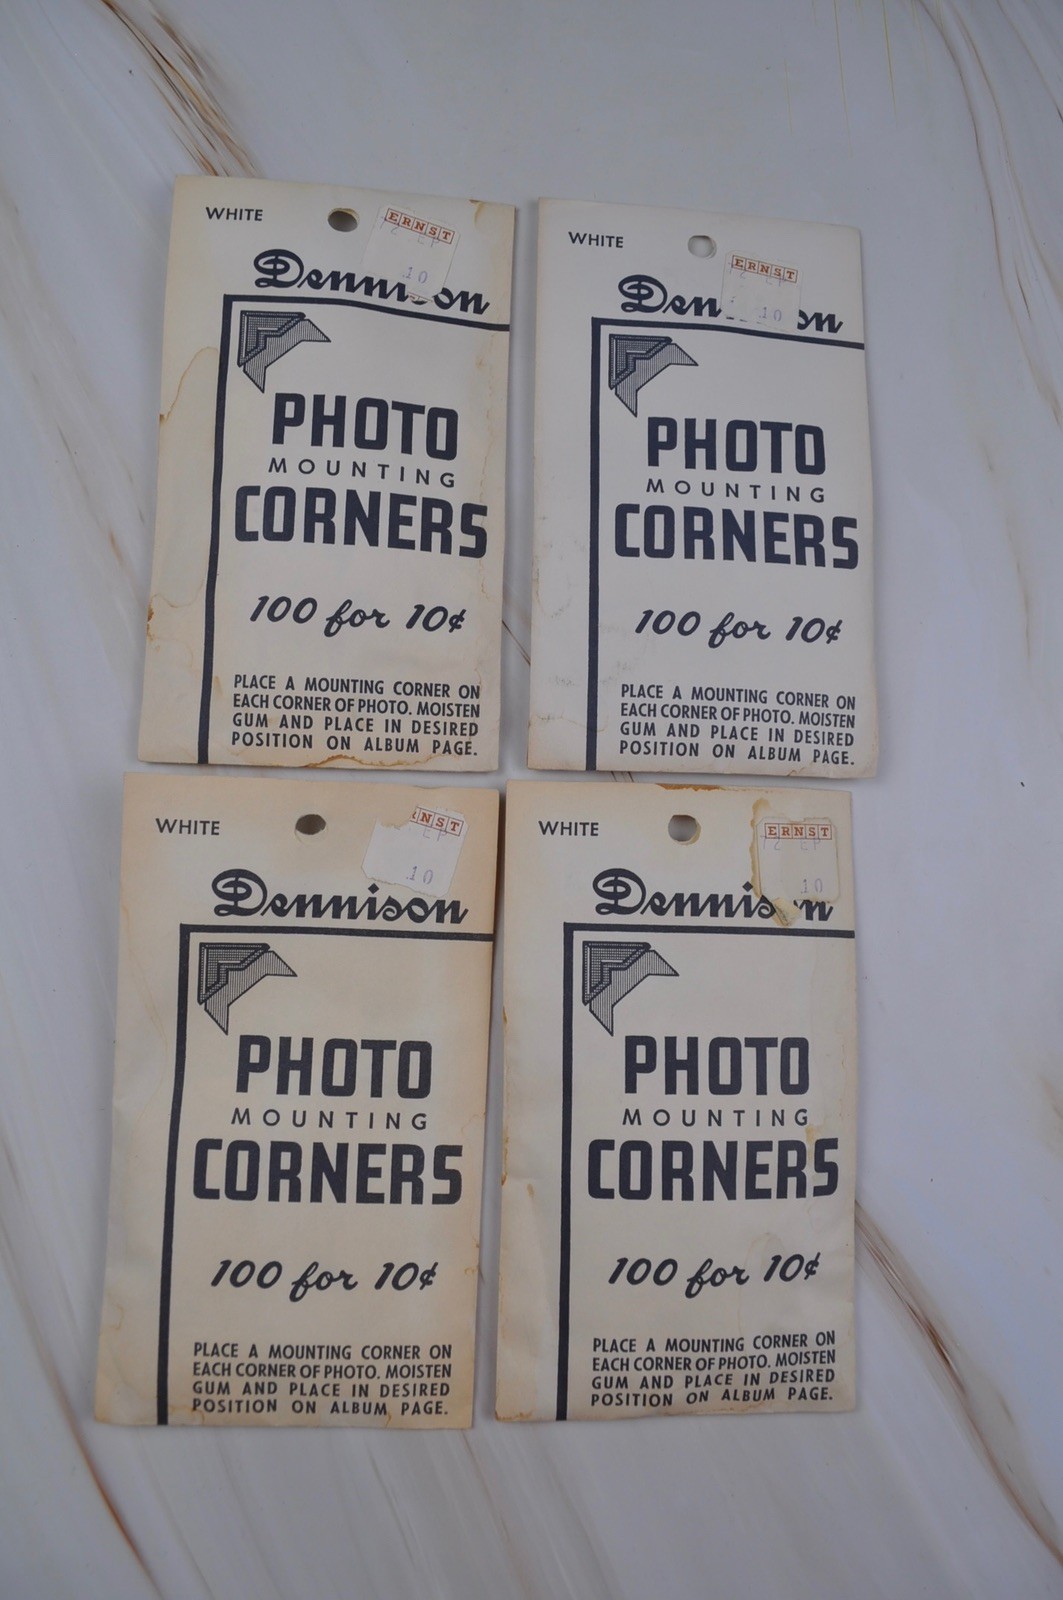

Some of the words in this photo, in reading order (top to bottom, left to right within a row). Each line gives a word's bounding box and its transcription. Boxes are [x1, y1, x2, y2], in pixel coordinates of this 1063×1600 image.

[205, 206, 264, 222] WHITE
[388, 211, 452, 239] ERNST
[567, 231, 624, 249] WHITE
[253, 248, 491, 316] Dennion
[734, 258, 796, 280] ERNST
[617, 274, 844, 334] Dennon
[271, 392, 459, 461] PHOTO
[647, 416, 826, 476] PHOTO
[268, 457, 456, 489] MOUNTING
[645, 478, 825, 504] MOUNTING
[234, 485, 488, 559] CORNERS
[614, 503, 859, 570] CORNERS
[249, 595, 318, 624] 100
[323, 598, 391, 638] for
[405, 603, 468, 634] 10¢
[634, 609, 701, 637] 100
[707, 611, 772, 649] for
[785, 616, 843, 645] 10¢
[233, 674, 276, 690] PLACE
[284, 675, 295, 691] A
[304, 676, 385, 695] MOUNTING
[392, 680, 451, 698] CORNER
[458, 684, 481, 700] ON
[621, 683, 664, 699] PLACE
[672, 685, 682, 700] A
[690, 686, 768, 705] MOUNTING
[775, 690, 829, 709] CORNER
[836, 695, 856, 711] ON
[233, 693, 270, 709] EACH
[272, 694, 332, 712] CORNER
[334, 697, 355, 713] OF
[357, 698, 412, 715] PHOTO.
[416, 701, 481, 719] MOISTEN
[620, 702, 657, 718] EACH
[660, 703, 718, 721] CORNER
[720, 706, 740, 721] OF
[743, 707, 795, 725] PHOTO.
[798, 710, 856, 729] MOISTEN
[232, 712, 269, 728] GUM
[278, 714, 314, 730] AND
[324, 716, 374, 733] PLACE
[384, 718, 402, 734] IN
[411, 719, 479, 737] DESIRED
[620, 721, 657, 737] GUM
[666, 722, 700, 738] AND
[710, 724, 759, 741] PLACE
[768, 727, 785, 743] IN
[793, 729, 854, 747] DESIRED
[231, 731, 313, 749] POSITION
[326, 735, 351, 751] ON
[363, 736, 420, 754] ALBUM
[432, 739, 478, 756] PAGE.
[619, 739, 700, 757] POSITION
[712, 743, 736, 759] ON
[747, 745, 801, 763] ALBUM
[812, 748, 855, 766] PAGE.
[155, 817, 220, 836] WHITE
[538, 820, 599, 837] WHITE
[766, 825, 830, 838] ERNST
[211, 868, 469, 925] Dennison
[592, 867, 834, 922] Dennisn
[235, 1034, 433, 1100] PHOTO
[624, 1035, 810, 1096] PHOTO
[230, 1107, 427, 1131] MOUNTING
[622, 1108, 808, 1128] MOUNTING
[192, 1137, 464, 1205] CORNERS
[587, 1137, 839, 1202] CORNERS
[210, 1259, 283, 1290] 100
[288, 1261, 359, 1303] for
[374, 1261, 439, 1291] 10¢
[607, 1257, 679, 1287] 100
[684, 1257, 750, 1300] for
[763, 1251, 821, 1283] 10¢
[193, 1341, 239, 1358] PLACE
[248, 1343, 259, 1359] A
[268, 1344, 352, 1361] MOUNTING
[360, 1344, 421, 1361] CORNER
[429, 1343, 453, 1360] ON
[592, 1337, 637, 1353] PLACE
[645, 1337, 656, 1353] A
[664, 1336, 745, 1353] MOUNTING
[752, 1333, 808, 1350] CORNER
[815, 1329, 836, 1347] ON
[192, 1361, 232, 1377] EACH
[235, 1362, 297, 1378] CORNER
[299, 1364, 321, 1379] OF
[323, 1364, 381, 1380] PHOTO.
[385, 1363, 452, 1380] MOISTEN
[592, 1356, 630, 1372] EACH
[633, 1356, 692, 1372] CORNER
[694, 1356, 716, 1372] OF
[717, 1353, 772, 1371] PHOTO.
[774, 1348, 836, 1368] MOISTEN
[192, 1380, 231, 1396] GUM
[241, 1380, 278, 1396] AND
[289, 1381, 341, 1398] PLACE
[351, 1383, 370, 1399] IN
[379, 1382, 451, 1399] DESIRED
[591, 1375, 629, 1390] GUM
[639, 1374, 674, 1390] AND
[684, 1373, 734, 1390] PLACE
[743, 1372, 761, 1387] IN
[768, 1368, 836, 1385] DESIRED
[190, 1397, 278, 1414] POSITION
[291, 1399, 317, 1415] ON
[329, 1400, 388, 1417] ALBUM
[400, 1400, 449, 1417] PAGE.
[590, 1392, 674, 1408] POSITION
[685, 1388, 710, 1405] ON
[720, 1387, 776, 1403] ALBUM
[787, 1386, 834, 1402] PAGE.
